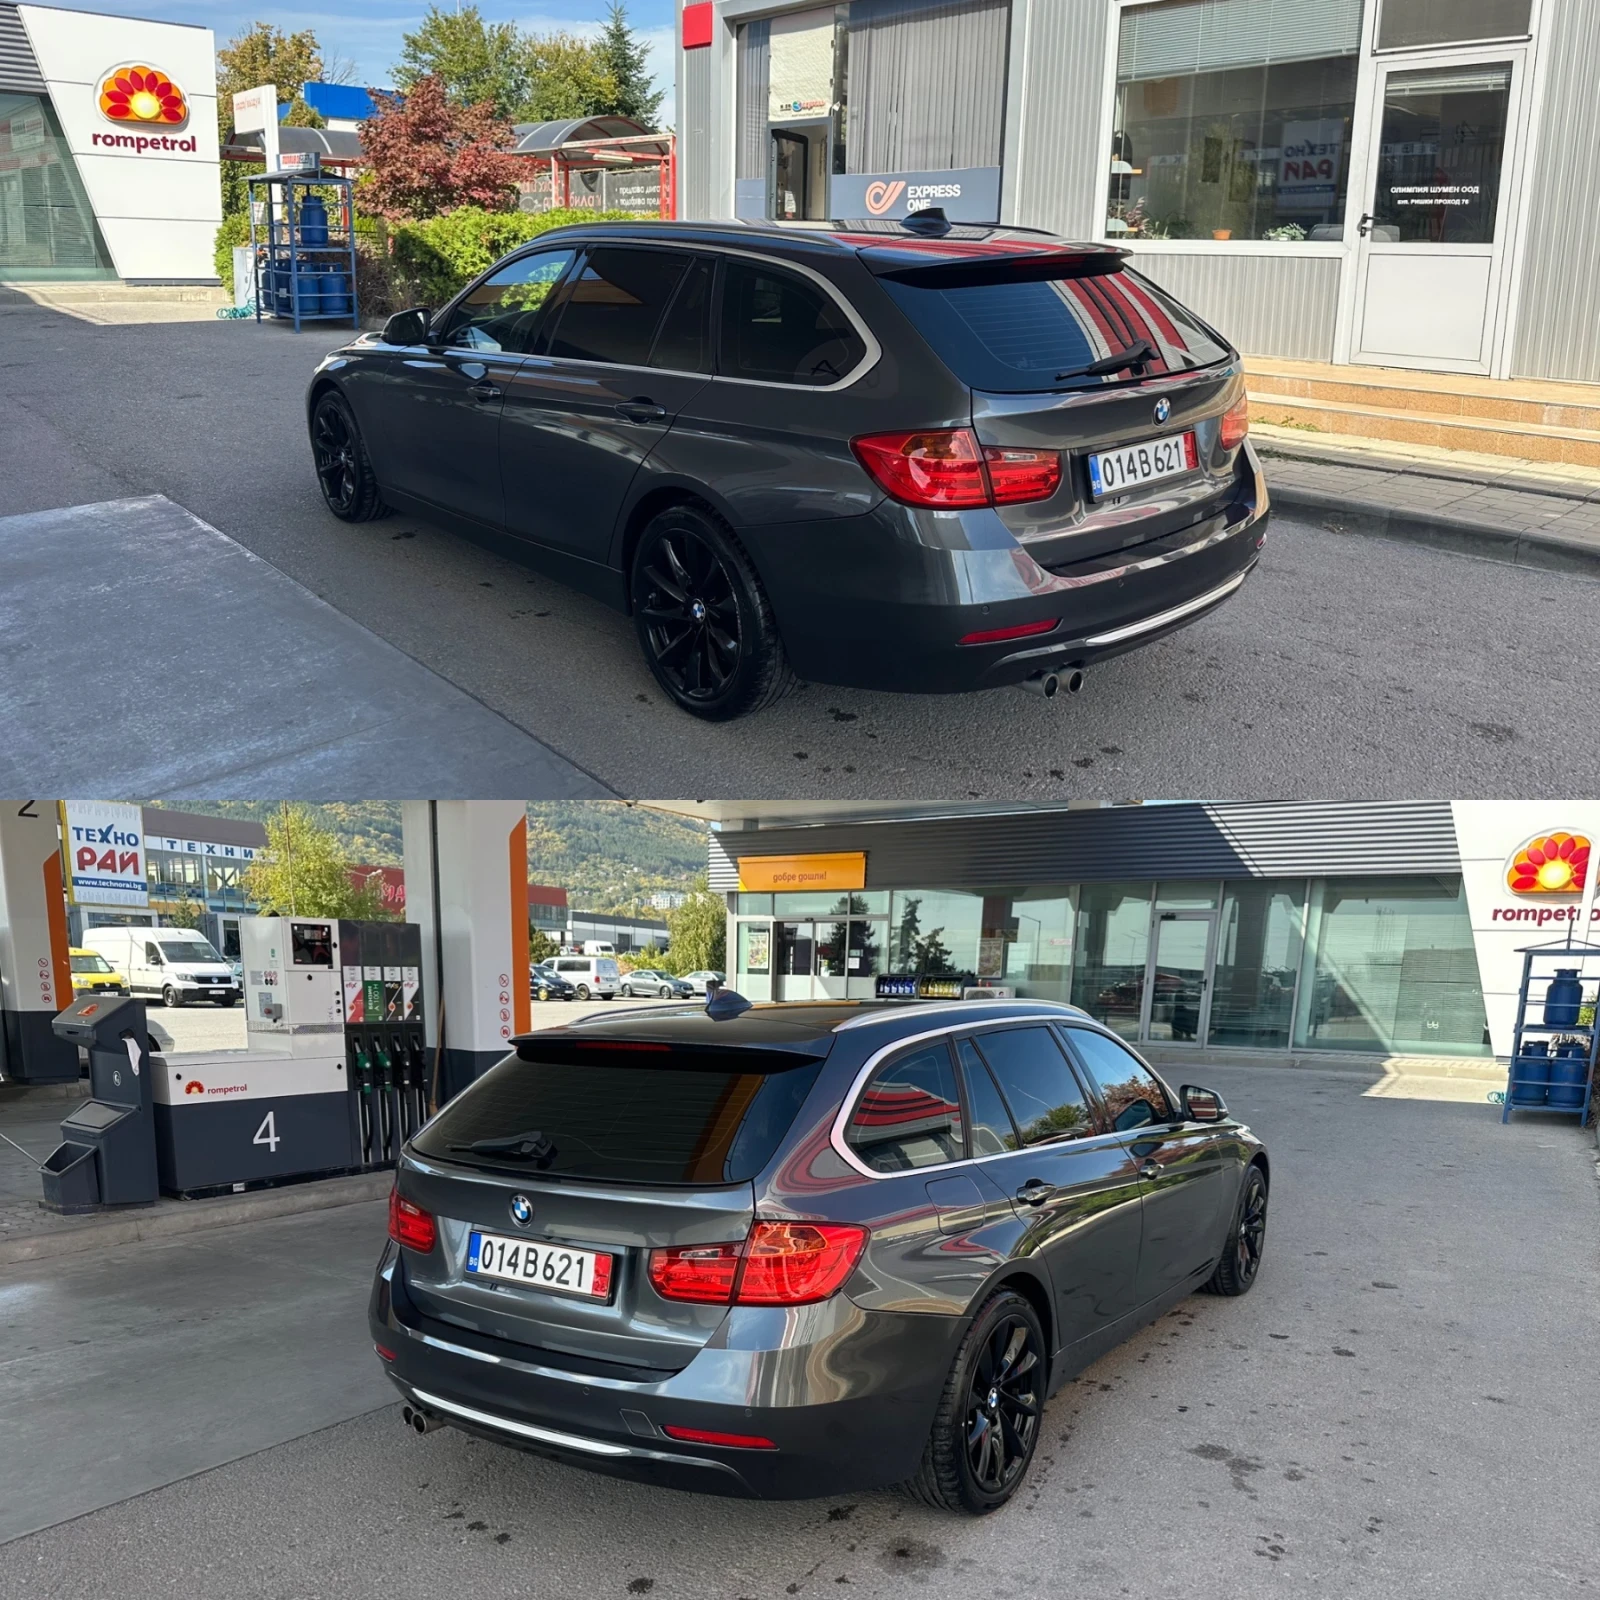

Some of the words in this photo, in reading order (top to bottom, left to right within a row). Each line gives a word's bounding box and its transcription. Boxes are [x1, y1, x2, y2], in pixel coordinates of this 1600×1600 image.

[92, 131, 196, 153] rompetrol
[907, 184, 961, 198] EXPRESS
[1390, 186, 1429, 194] ОЛИМПИЯ
[1430, 186, 1460, 194] ШУМЕН
[1461, 186, 1480, 194] ООД
[906, 199, 932, 212] ONE
[72, 823, 139, 847] ТЕХНО
[167, 840, 254, 859] ТЕХНИ
[76, 847, 140, 875] РАЙ
[772, 871, 797, 884] добре
[798, 870, 827, 883] дошли!
[77, 879, 142, 891] www.technorai.bg
[207, 1084, 248, 1095] rompetrol
[253, 1111, 281, 1152] 4
[469, 1257, 478, 1266] BG
